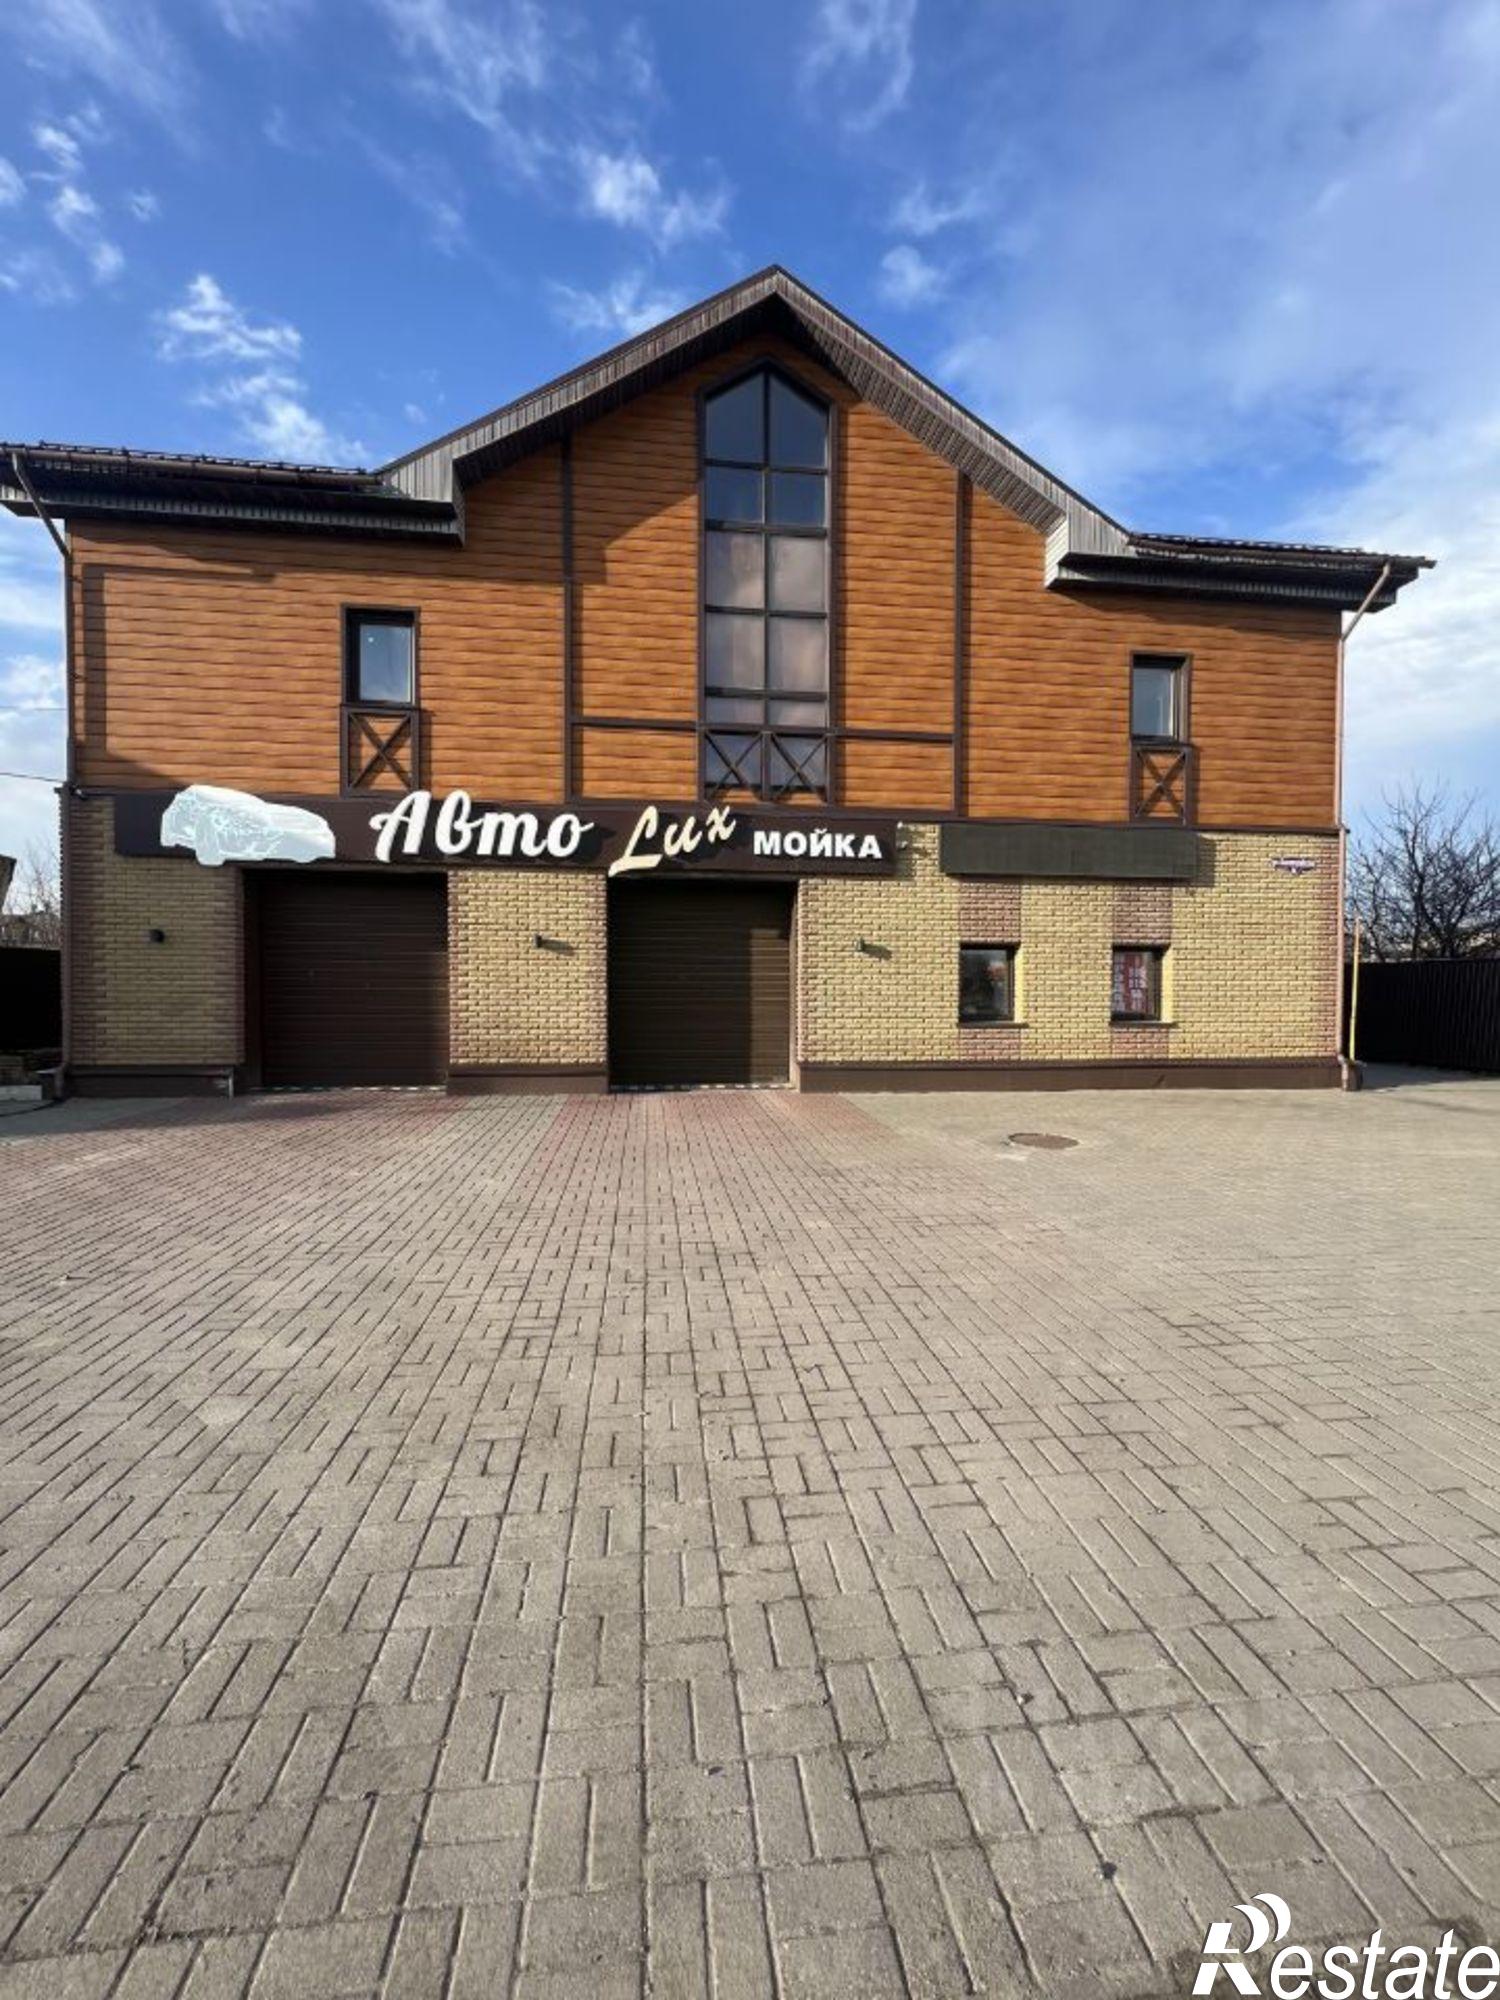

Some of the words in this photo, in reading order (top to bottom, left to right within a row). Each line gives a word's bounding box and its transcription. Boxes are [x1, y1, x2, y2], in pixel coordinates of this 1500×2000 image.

[369, 790, 595, 863] Авто
[608, 805, 736, 877] Lux
[753, 827, 882, 859] МОЙКА
